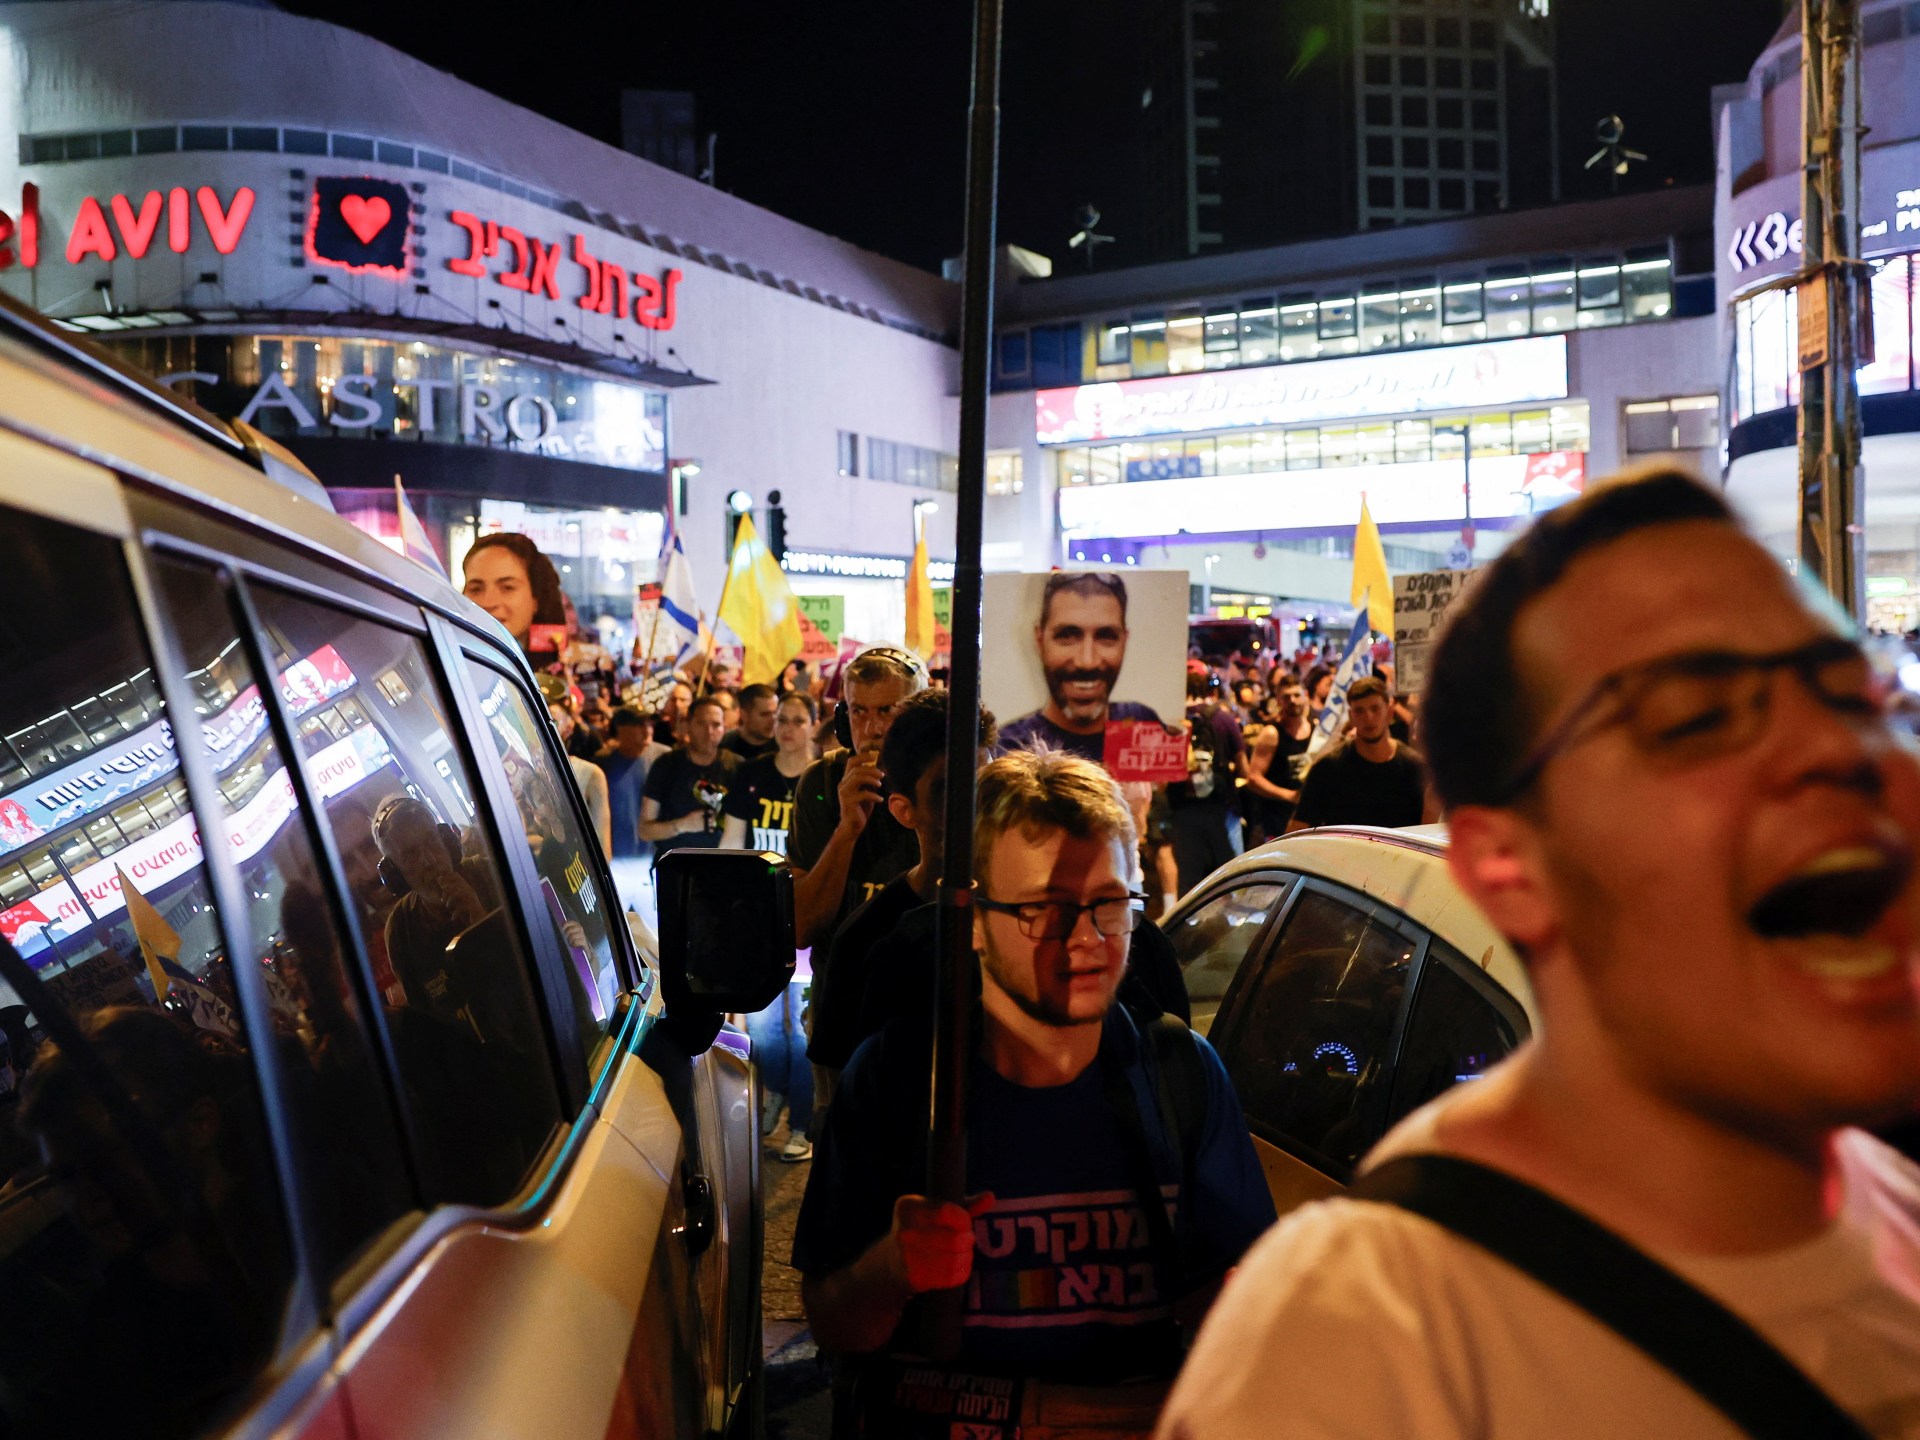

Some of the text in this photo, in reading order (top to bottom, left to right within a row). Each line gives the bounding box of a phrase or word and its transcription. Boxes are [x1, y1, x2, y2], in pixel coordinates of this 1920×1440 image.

[66, 186, 255, 263] AVIV
[450, 210, 561, 301] אביב
[575, 233, 628, 319] תל
